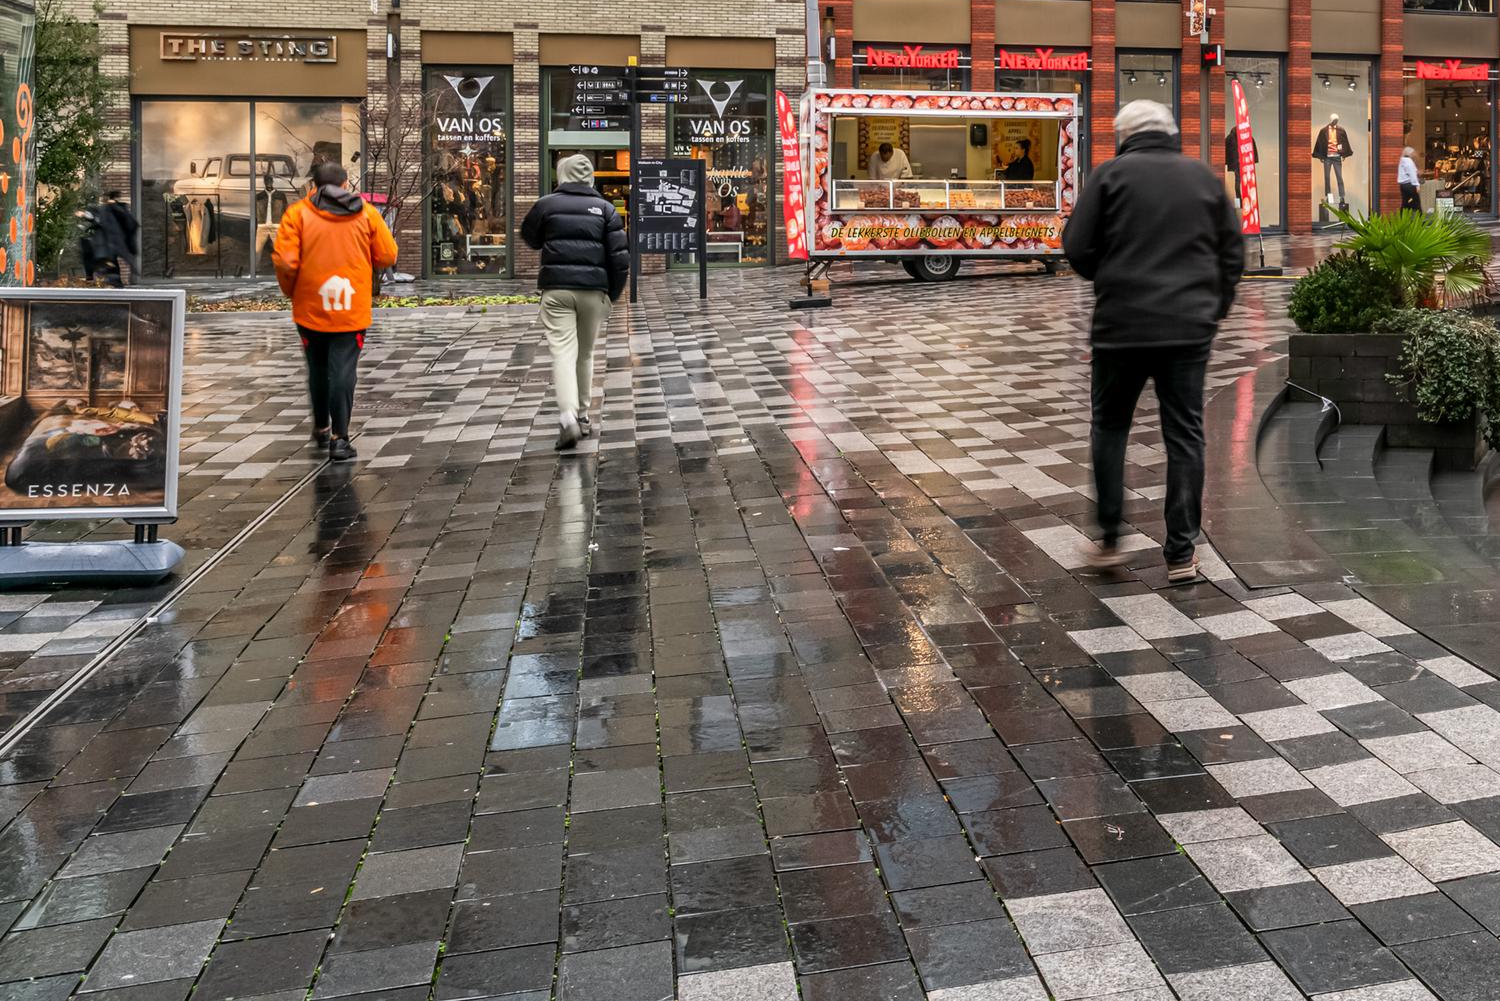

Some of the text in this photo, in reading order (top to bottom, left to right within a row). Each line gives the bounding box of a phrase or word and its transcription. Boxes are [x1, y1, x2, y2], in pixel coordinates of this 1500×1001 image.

[168, 39, 329, 57] THE STING
[437, 117, 502, 132] VAN OS
[690, 120, 751, 134] VAN OS
[831, 227, 845, 238] DE
[847, 227, 900, 238] LEKKERSTE
[903, 227, 960, 238] OLIEBOLLEN
[963, 227, 976, 238] EN
[979, 227, 1055, 238] APPELBEIGNETS
[28, 483, 130, 498] ESSENZA
